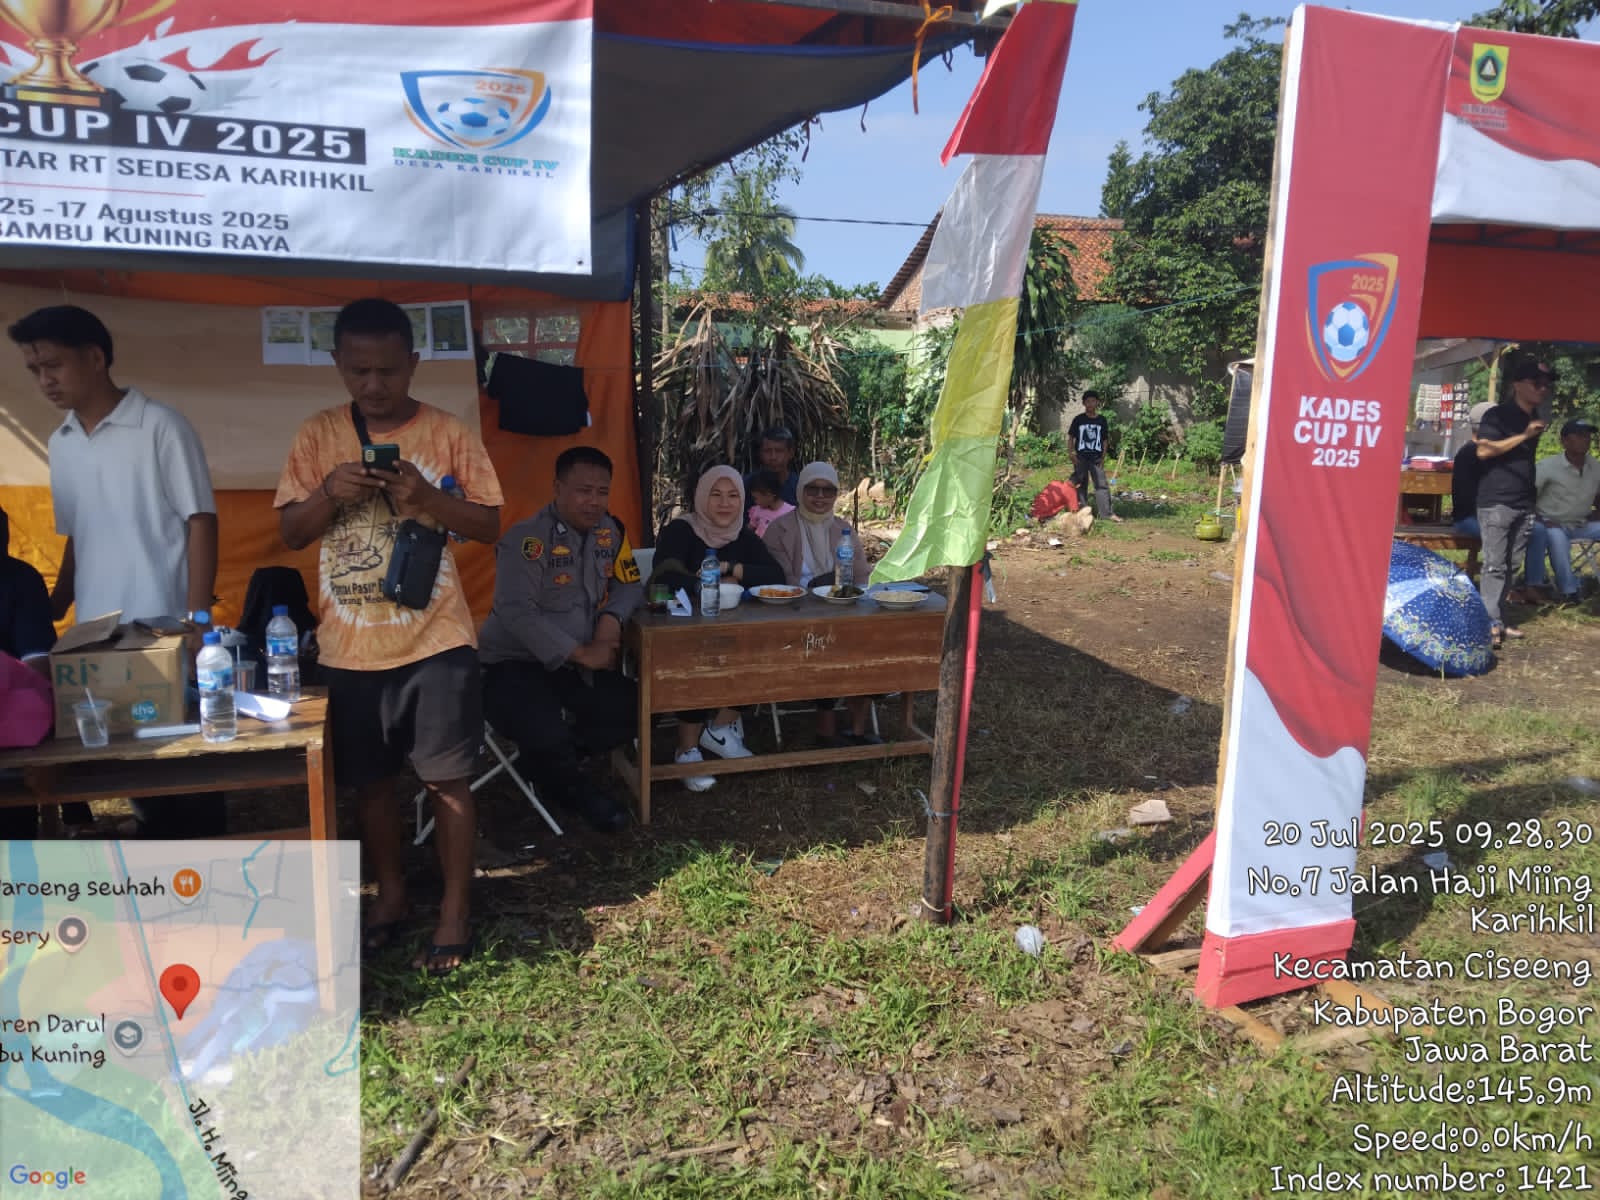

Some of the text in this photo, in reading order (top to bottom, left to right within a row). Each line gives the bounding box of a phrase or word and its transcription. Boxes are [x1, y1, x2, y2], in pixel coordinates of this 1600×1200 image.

[475, 80, 527, 94] 2025
[0, 102, 351, 160] CUP IV 2025
[0, 148, 374, 193] TAR RT SEDESA KARIHKIL
[392, 147, 560, 171] KADES CUP IV
[394, 158, 554, 179] DESA KARIHKIL
[98, 204, 213, 228] Agustus
[222, 211, 290, 231] 2025
[0, 219, 290, 253] AMBU KUNING RAYA
[1351, 274, 1385, 293] 2025
[1299, 395, 1381, 423] KADES
[1293, 420, 1383, 448] CUP IV
[1312, 448, 1361, 468] 2025
